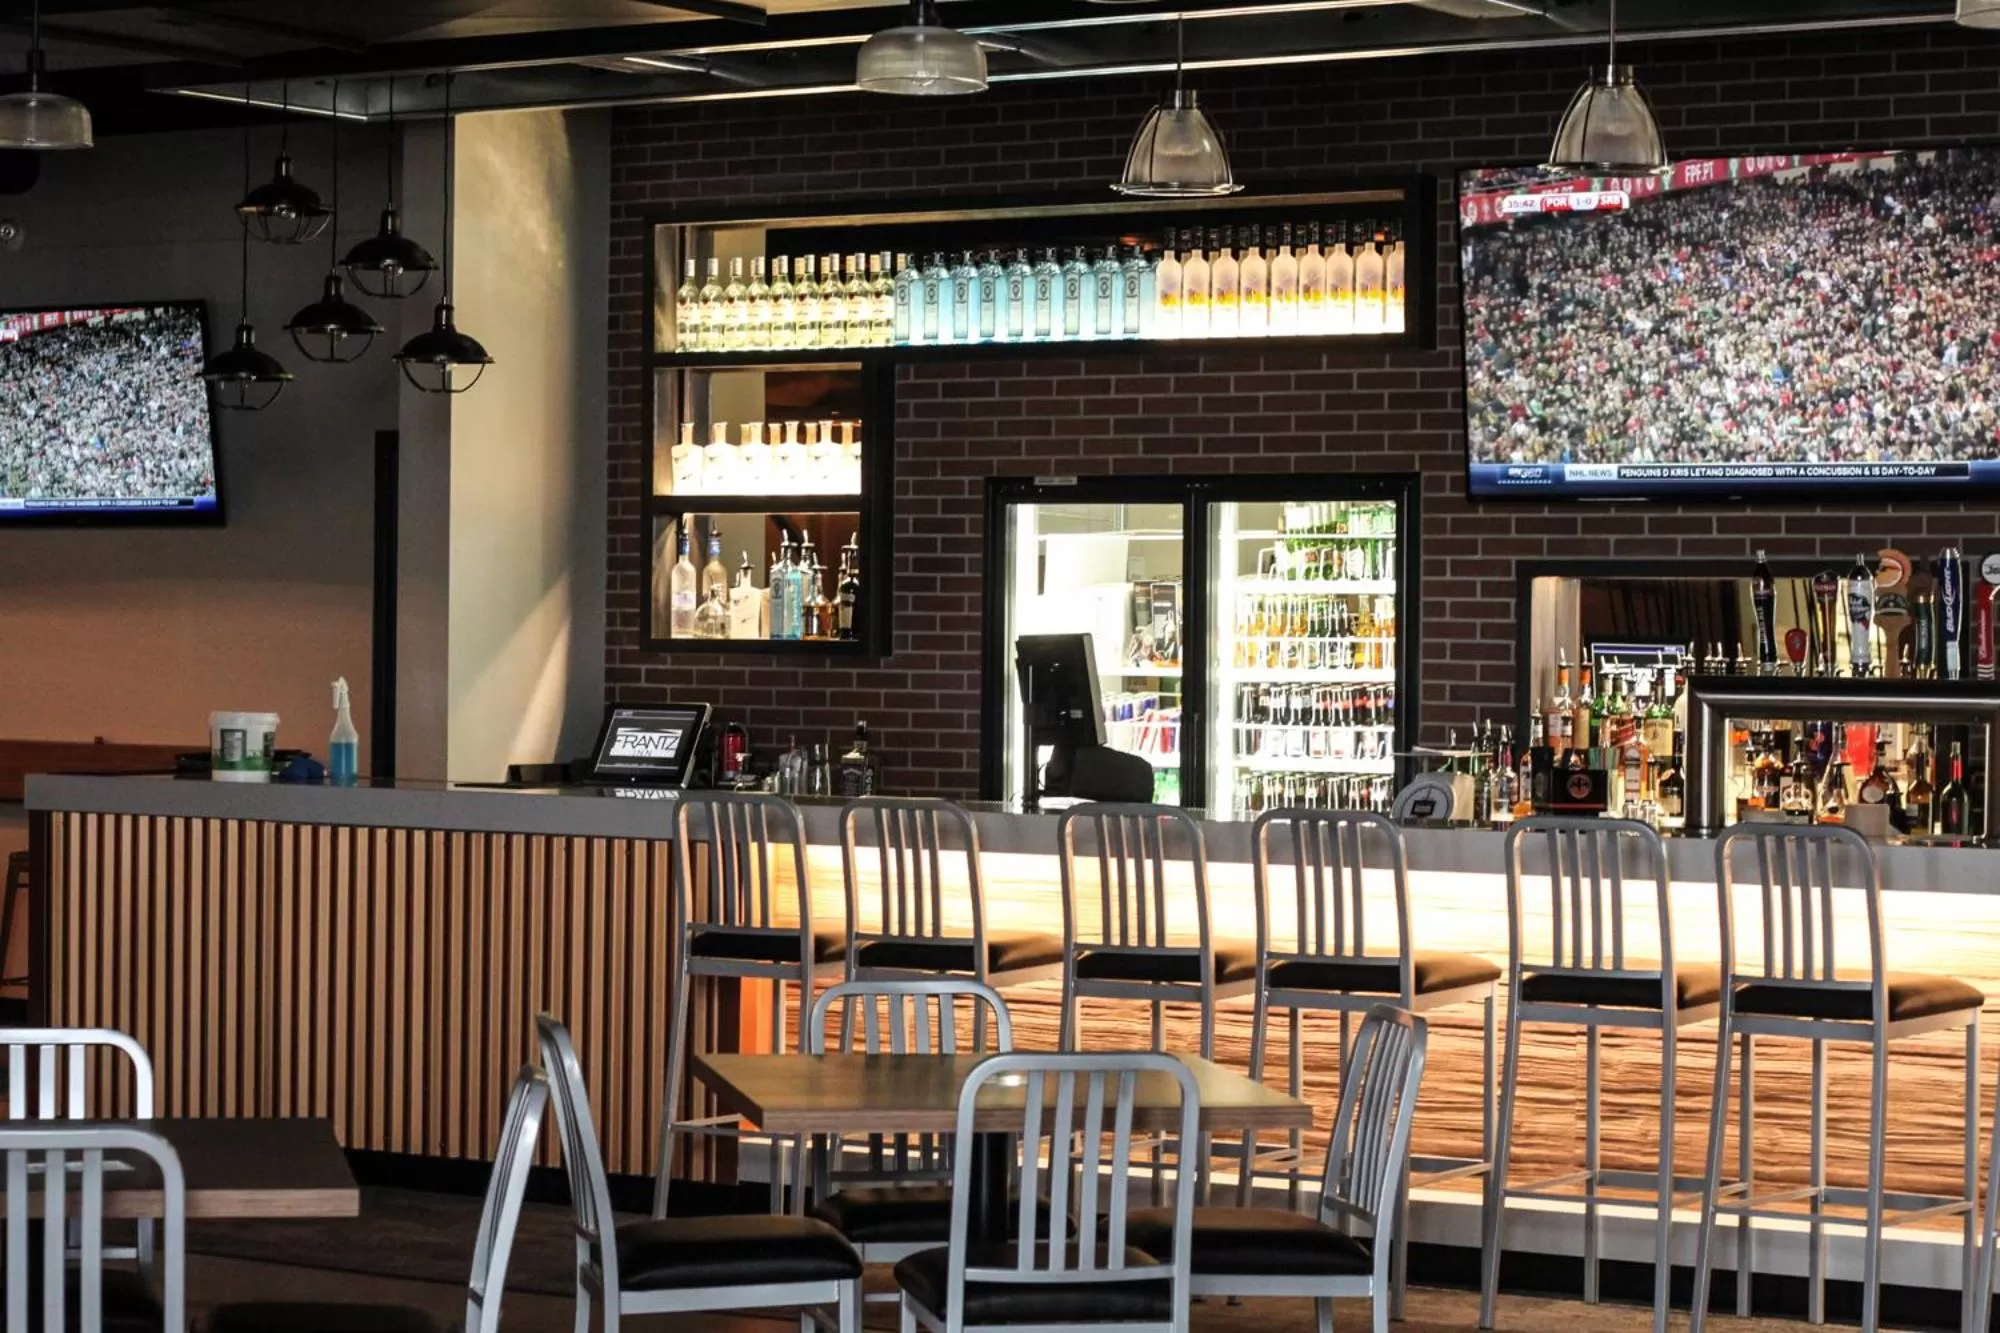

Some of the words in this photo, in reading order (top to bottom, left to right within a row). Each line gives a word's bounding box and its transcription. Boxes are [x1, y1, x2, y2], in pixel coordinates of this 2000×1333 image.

[1546, 195, 1568, 207] POR
[1568, 469, 1587, 478] NHL
[1588, 469, 1613, 478] NEWS
[1620, 468, 1661, 478] PENGUINS
[1662, 468, 1669, 478] D
[1670, 468, 1689, 477] KRIS
[1690, 468, 1724, 477] LETANG
[1725, 467, 1774, 477] DIAGNOSED
[1775, 467, 1797, 476] WITH
[1799, 467, 1806, 476] A
[1807, 466, 1862, 476] CONCUSSION
[1863, 466, 1870, 476] &
[1871, 466, 1880, 476] IS
[1881, 466, 1937, 476] DAY-TO-DAY
[616, 735, 679, 751] FRANTZ
